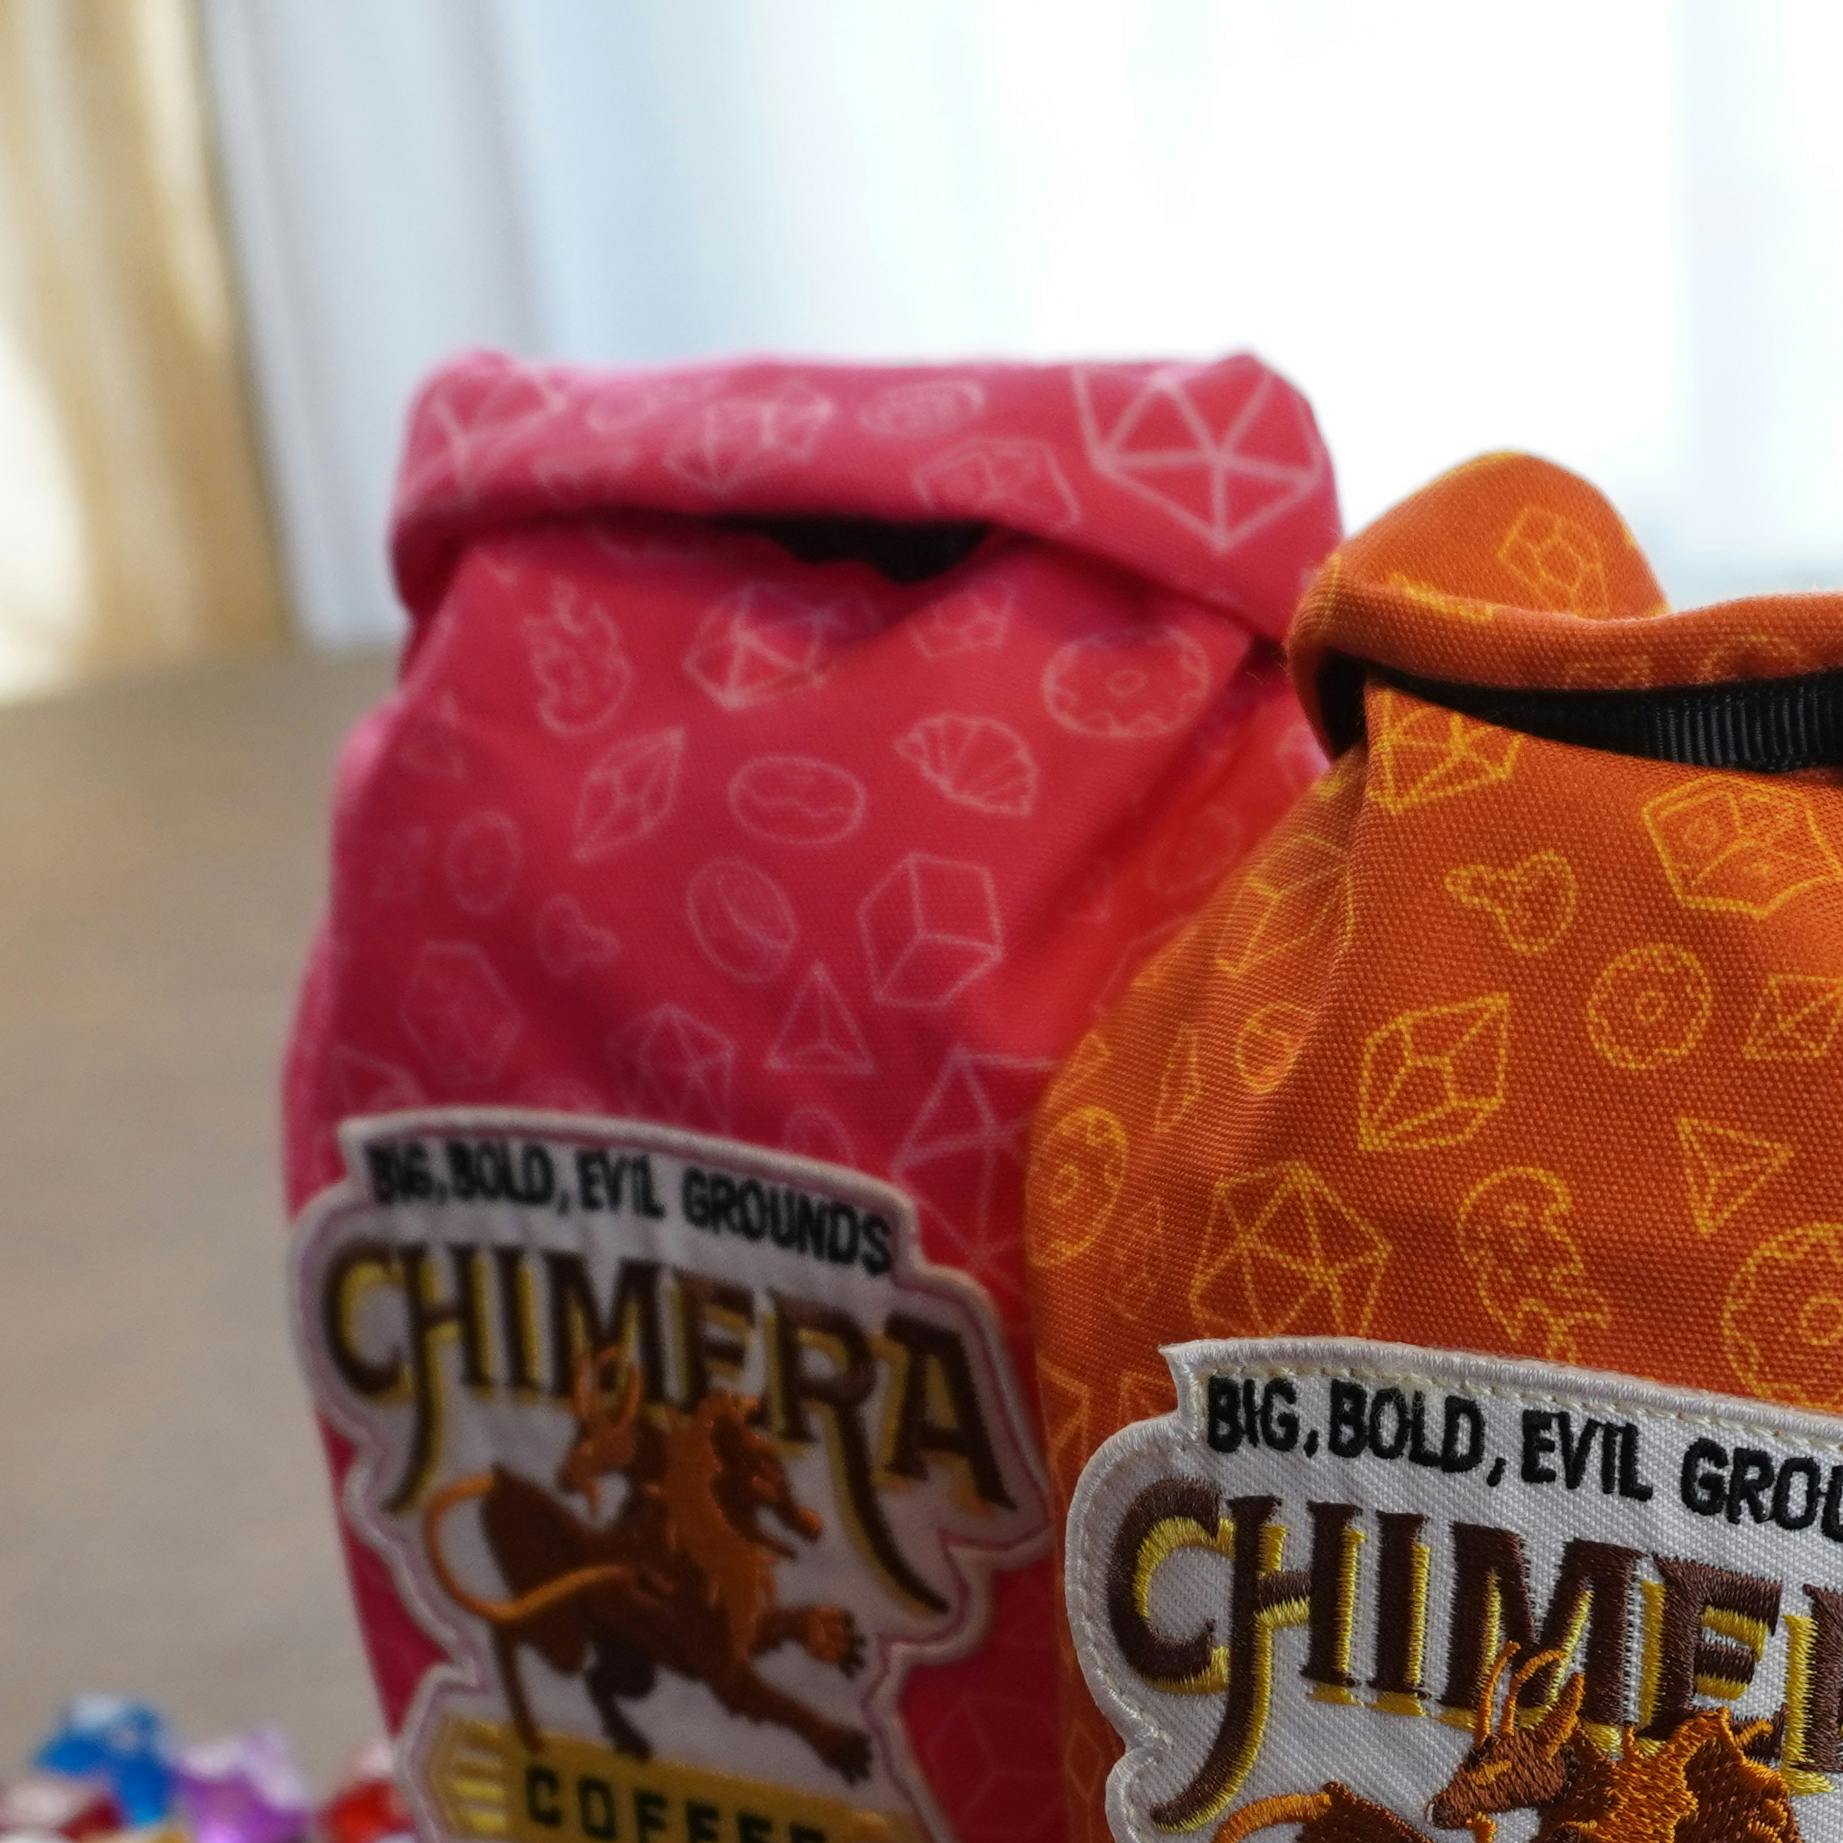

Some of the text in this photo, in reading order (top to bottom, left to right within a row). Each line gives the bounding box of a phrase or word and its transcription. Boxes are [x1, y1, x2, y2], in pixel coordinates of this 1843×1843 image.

[576, 1153, 666, 1220] EVIL
[682, 1167, 895, 1277] GROUNDS
[322, 1240, 1017, 1616] CHIMERA
[1522, 1408, 1653, 1502] EVIL
